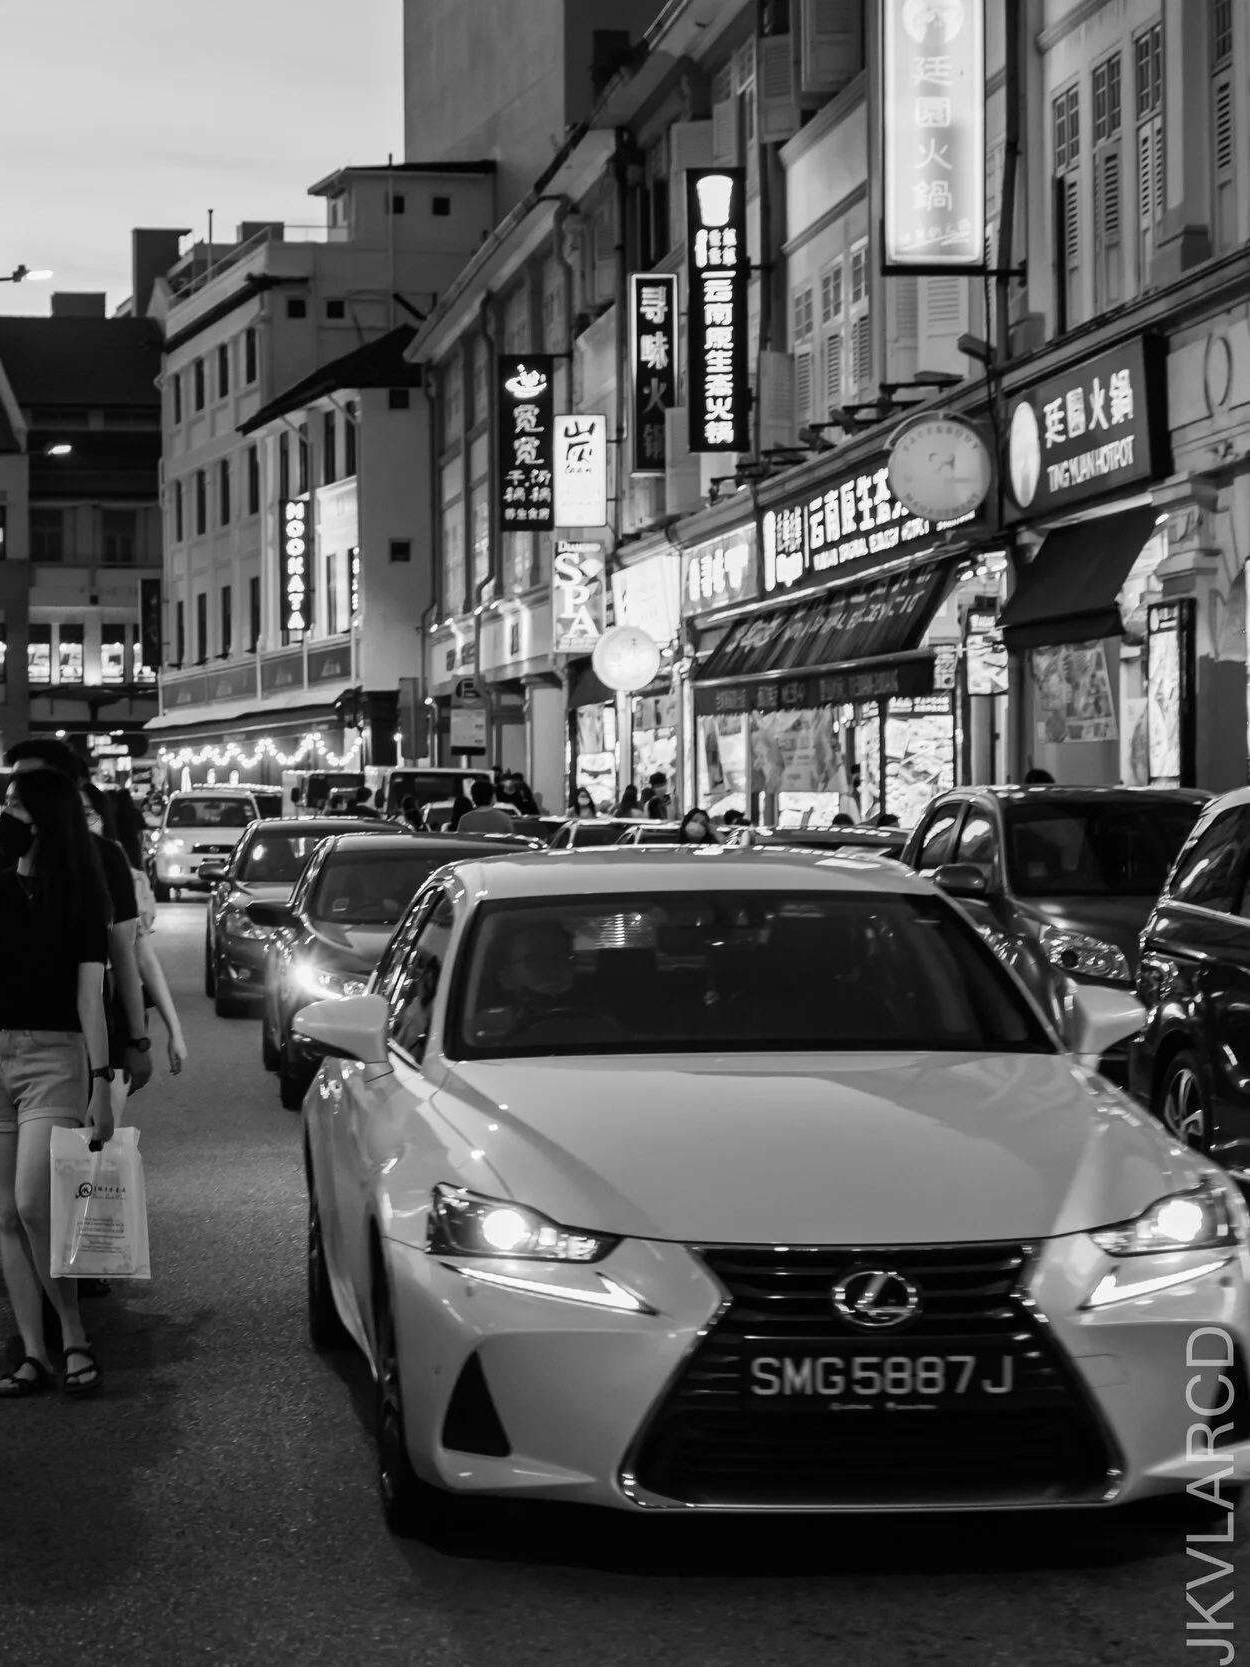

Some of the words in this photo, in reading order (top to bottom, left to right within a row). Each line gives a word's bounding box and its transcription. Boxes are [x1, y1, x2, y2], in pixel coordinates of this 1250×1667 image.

[285, 501, 305, 630] MOOKATA
[554, 552, 601, 639] SPA
[750, 1356, 1013, 1396] SMG5887J
